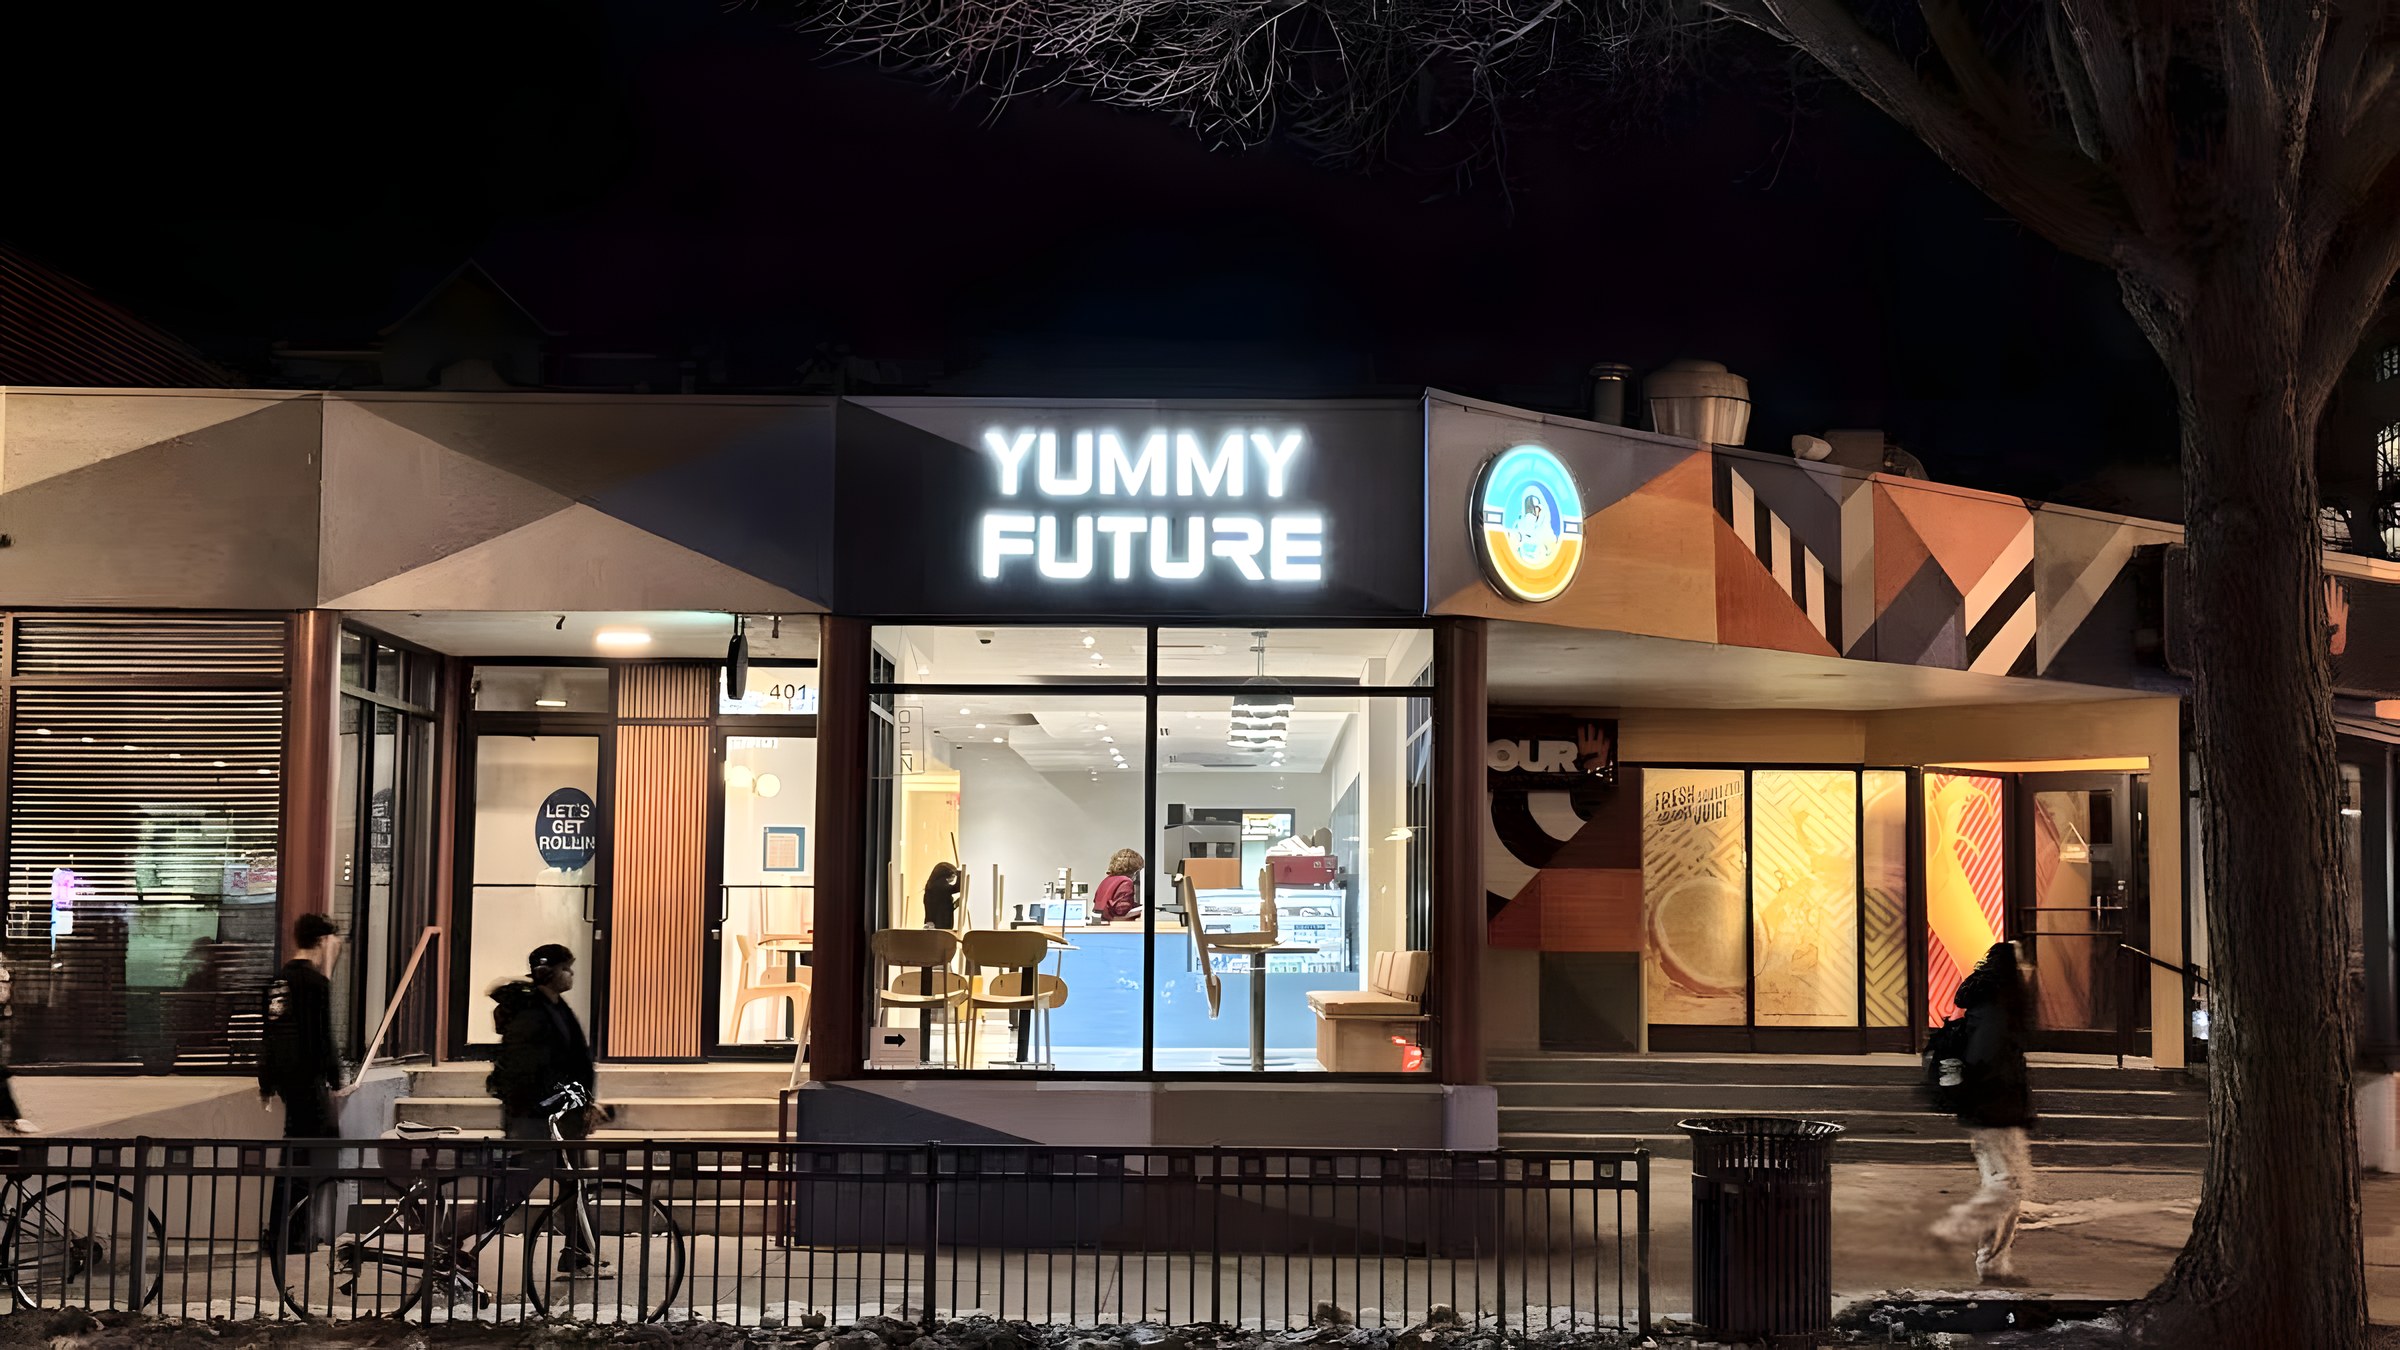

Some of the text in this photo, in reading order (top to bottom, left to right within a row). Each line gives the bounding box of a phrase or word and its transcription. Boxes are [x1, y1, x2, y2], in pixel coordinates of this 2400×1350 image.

[983, 431, 1303, 497] YUMMY
[981, 513, 1323, 581] FUTURE
[769, 684, 806, 700] 401
[546, 803, 590, 819] LET'S
[551, 819, 585, 834] GET
